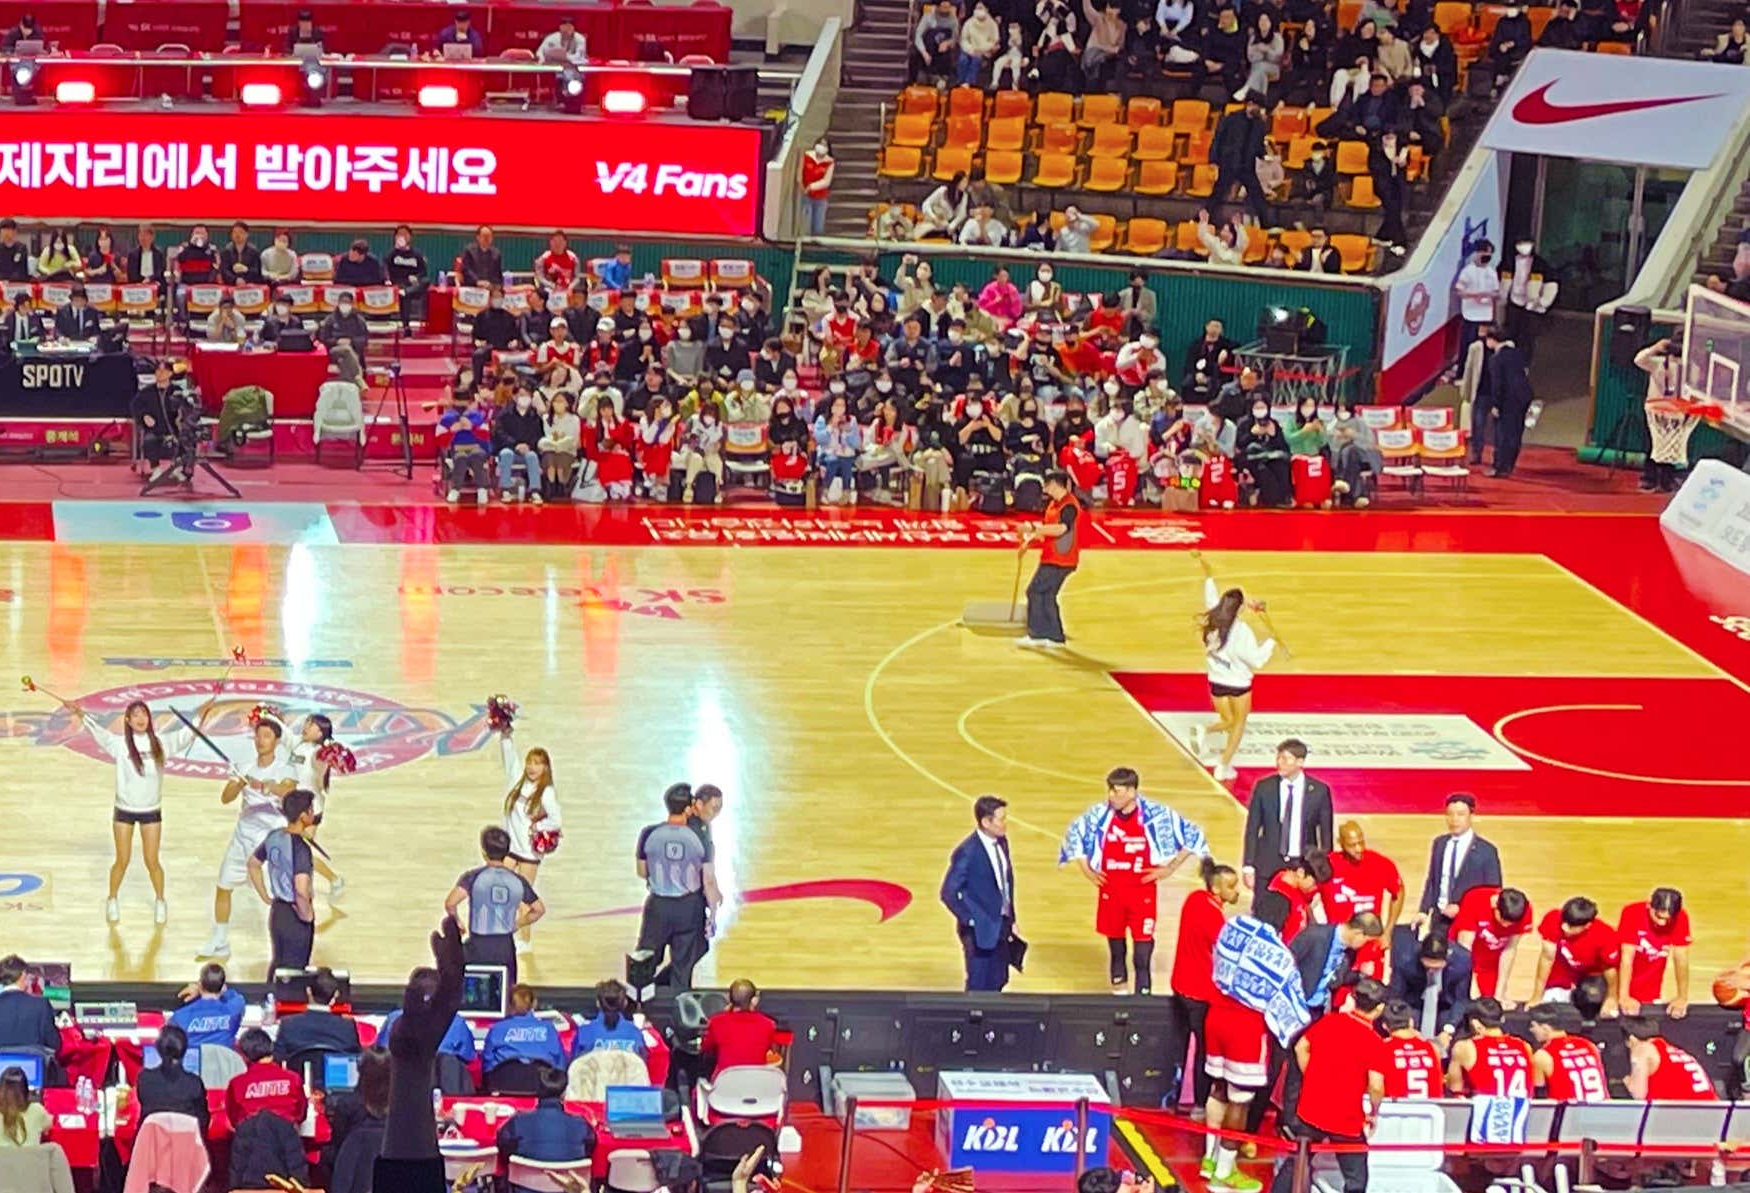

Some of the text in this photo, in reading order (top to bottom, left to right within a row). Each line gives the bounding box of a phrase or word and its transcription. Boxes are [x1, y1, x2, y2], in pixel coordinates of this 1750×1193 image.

[255, 143, 497, 195] 받아주세요
[595, 160, 748, 199] V4 Fans
[23, 364, 84, 388] SPOTV
[1406, 1069, 1429, 1100] 5
[1493, 1069, 1528, 1098] 14
[1569, 1068, 1606, 1101] 19
[962, 1124, 1019, 1152] KBL
